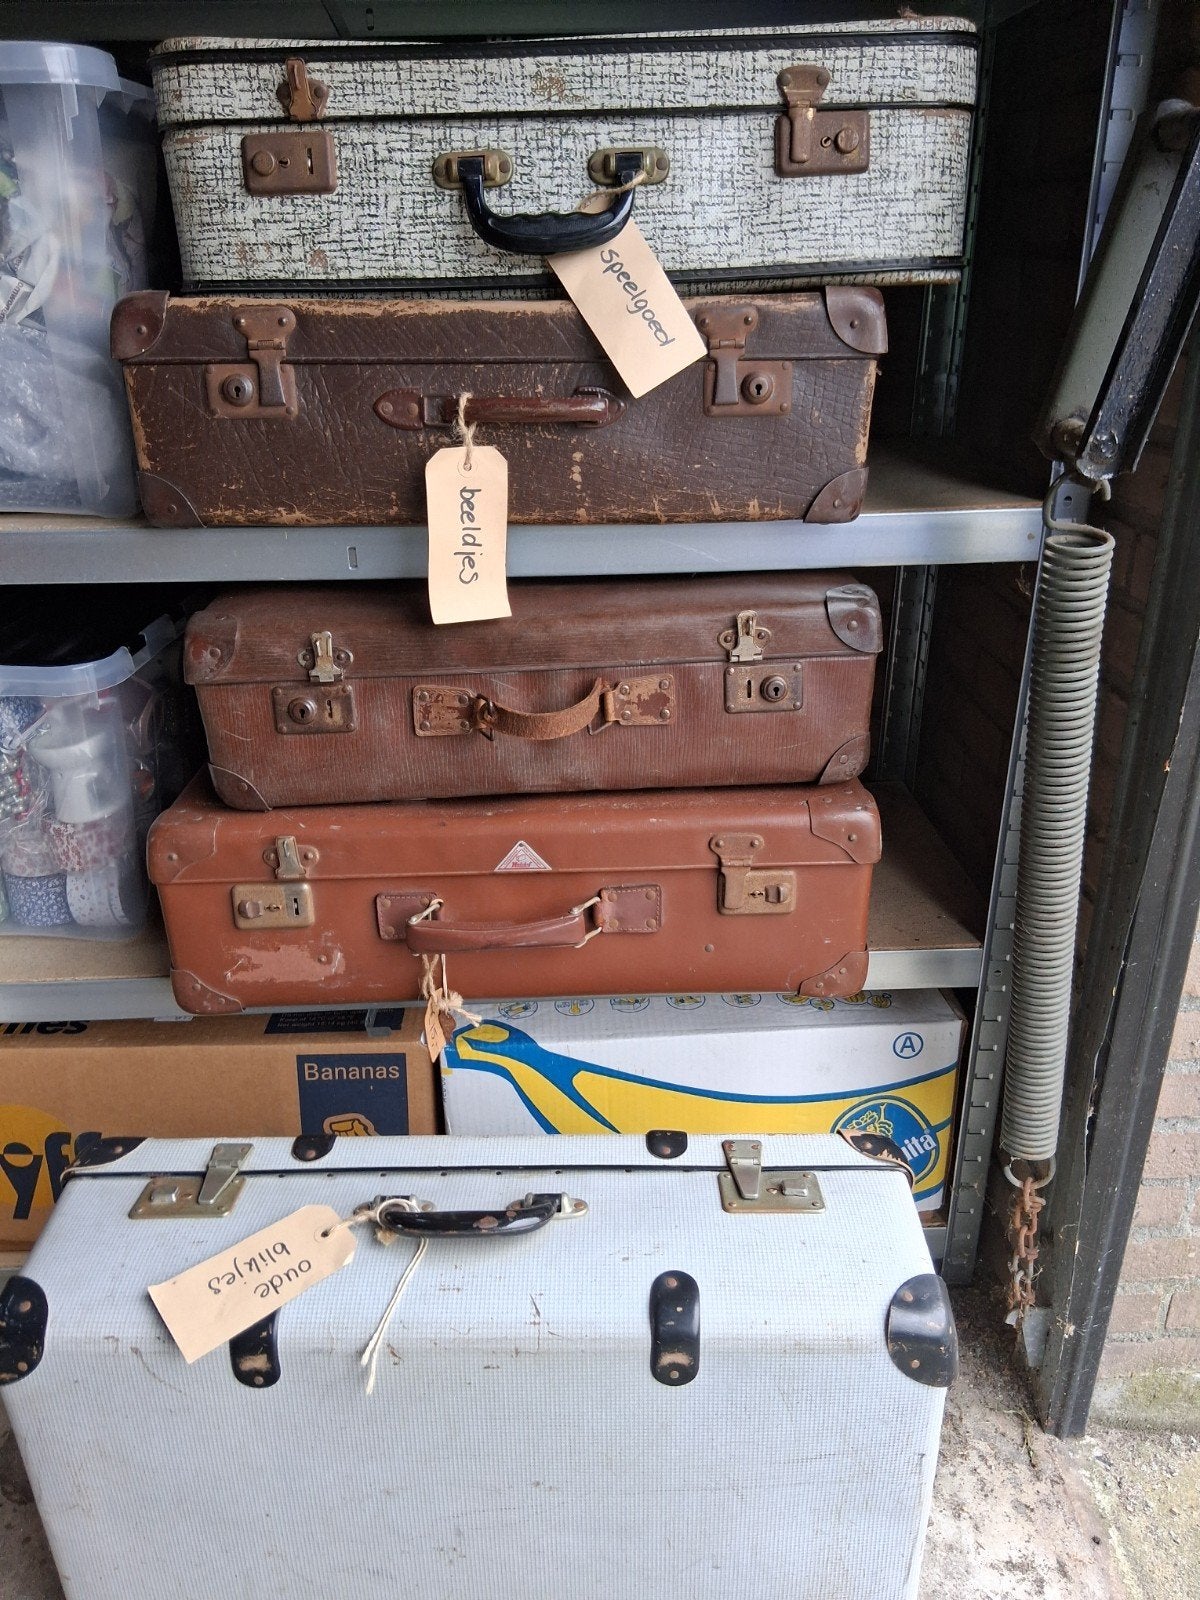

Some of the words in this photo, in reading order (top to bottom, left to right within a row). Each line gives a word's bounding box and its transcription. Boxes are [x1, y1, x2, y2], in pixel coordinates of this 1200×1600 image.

[453, 486, 483, 585] beeldjes
[900, 1035, 916, 1054] A
[304, 1062, 400, 1081] Bananas
[207, 1241, 291, 1295] blikjes
[253, 1259, 312, 1298] oude
